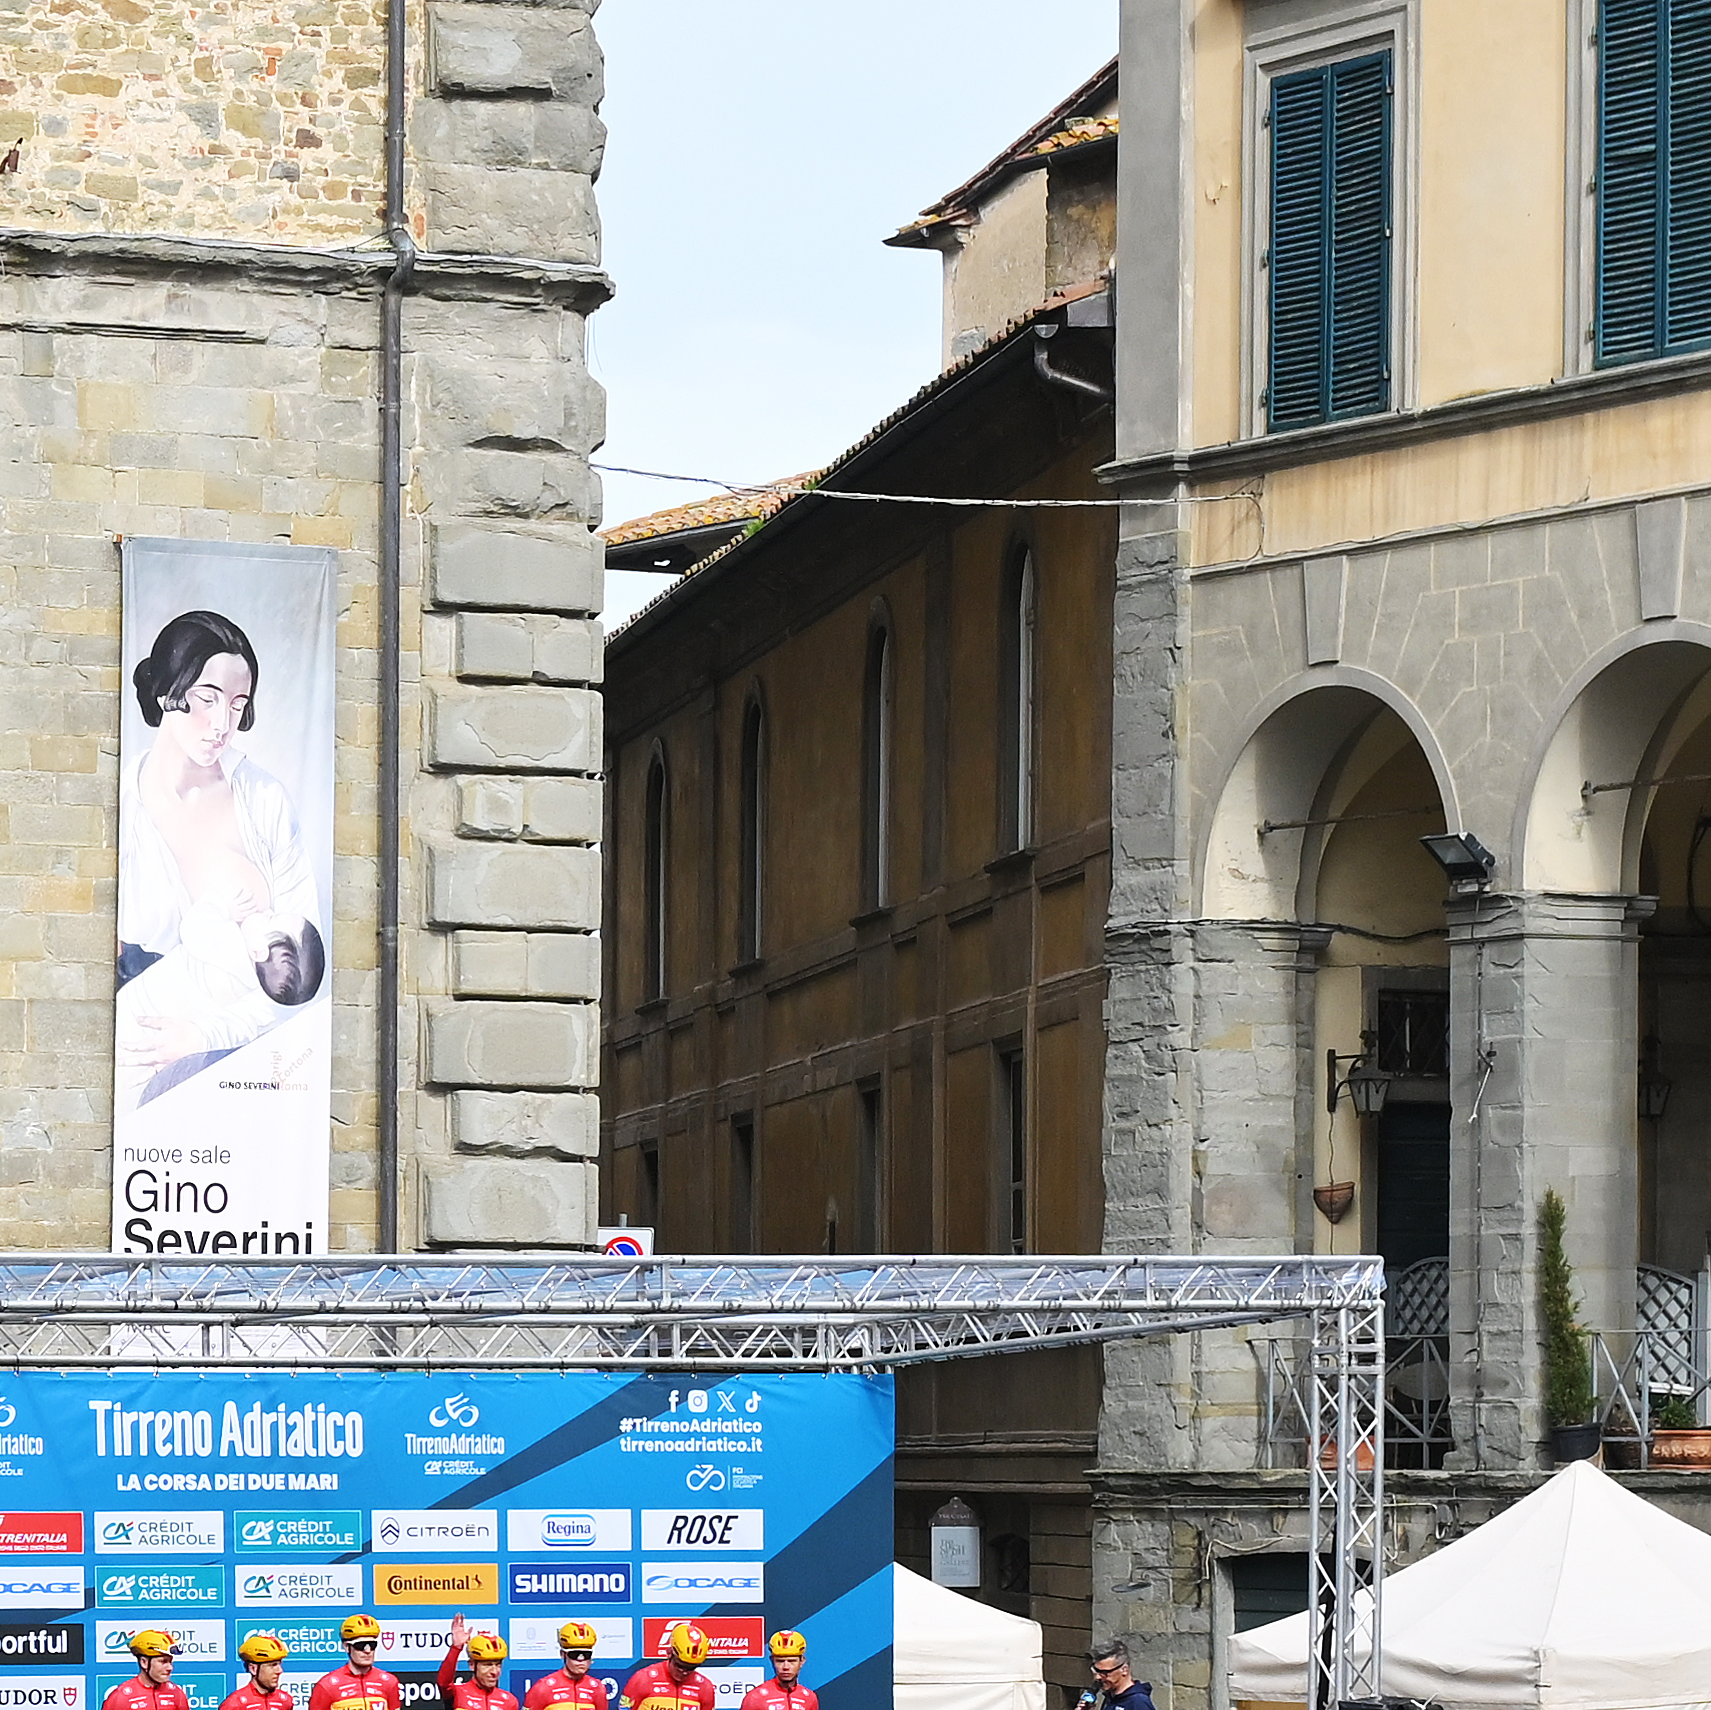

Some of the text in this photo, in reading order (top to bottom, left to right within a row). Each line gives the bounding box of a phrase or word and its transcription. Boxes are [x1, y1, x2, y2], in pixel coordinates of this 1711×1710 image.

[218, 1081, 241, 1090] GINO
[123, 1145, 231, 1165] nuove sale
[124, 1169, 229, 1214] Gino
[123, 1217, 313, 1255] Severini
[88, 1399, 364, 1459] Tirreno Adriatico
[618, 1416, 763, 1433] #TirrenoAdriatico
[404, 1432, 506, 1455] TirrenoAdriatico
[619, 1436, 764, 1452] tirrenoadriatico.it
[116, 1473, 339, 1491] LA CORSA DEI DUE MARI
[138, 1518, 196, 1533] CRÉDIT
[276, 1517, 334, 1532] CRÉDIT
[406, 1522, 490, 1538] CITROËN
[545, 1517, 592, 1538] Regina
[667, 1514, 739, 1544] ROSE
[0, 1532, 68, 1544] TRENITALIA
[138, 1533, 217, 1546] AGRICOLE
[276, 1532, 355, 1546] AGRICOLE
[138, 1573, 196, 1587] CRÉDIT
[277, 1572, 334, 1586] CRÉDIT
[386, 1572, 471, 1594] Continental
[513, 1572, 626, 1595] SHIMANO
[138, 1587, 218, 1601] AGRICOLE
[278, 1585, 356, 1599] AGRICOLE
[277, 1625, 335, 1640] CRÉDIT
[399, 1632, 453, 1648] TUD
[281, 1640, 346, 1653] AGRICOL
